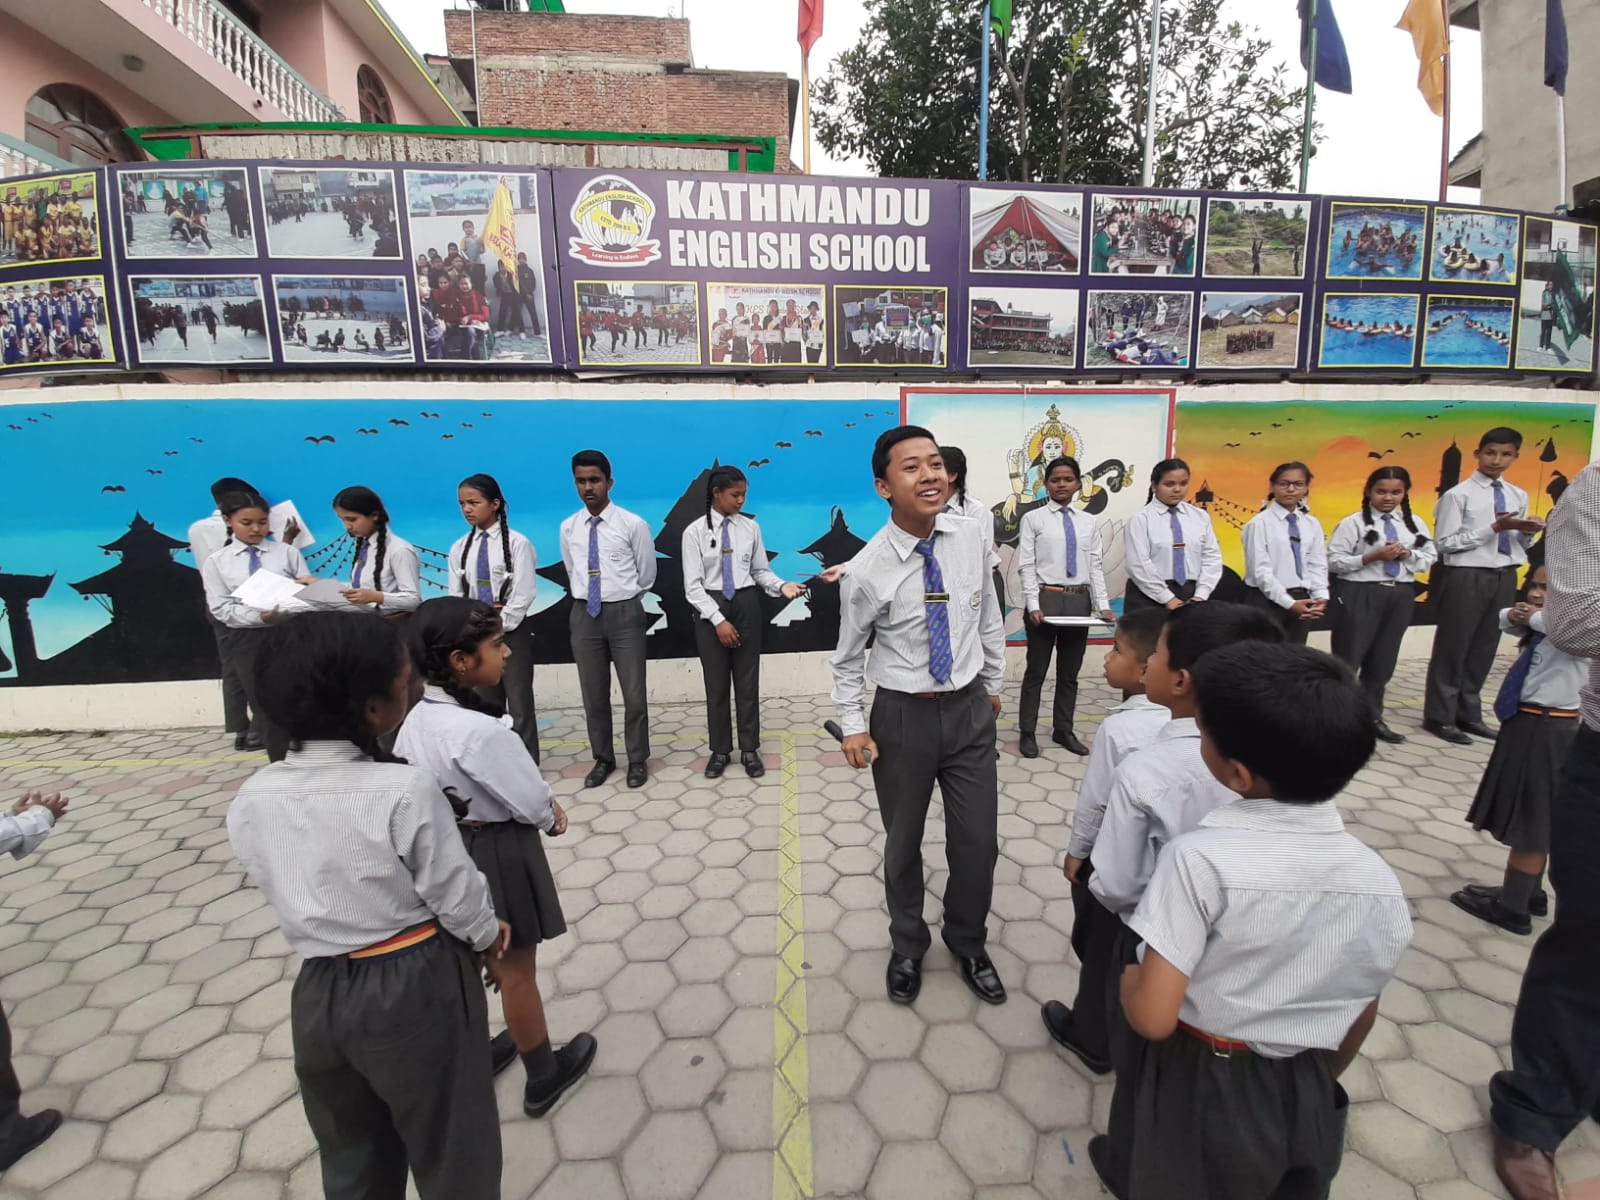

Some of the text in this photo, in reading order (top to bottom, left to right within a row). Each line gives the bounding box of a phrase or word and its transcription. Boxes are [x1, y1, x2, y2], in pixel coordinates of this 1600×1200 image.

[666, 180, 931, 226] KATHMANDU
[669, 229, 931, 273] ENGLISH SCHOOL
